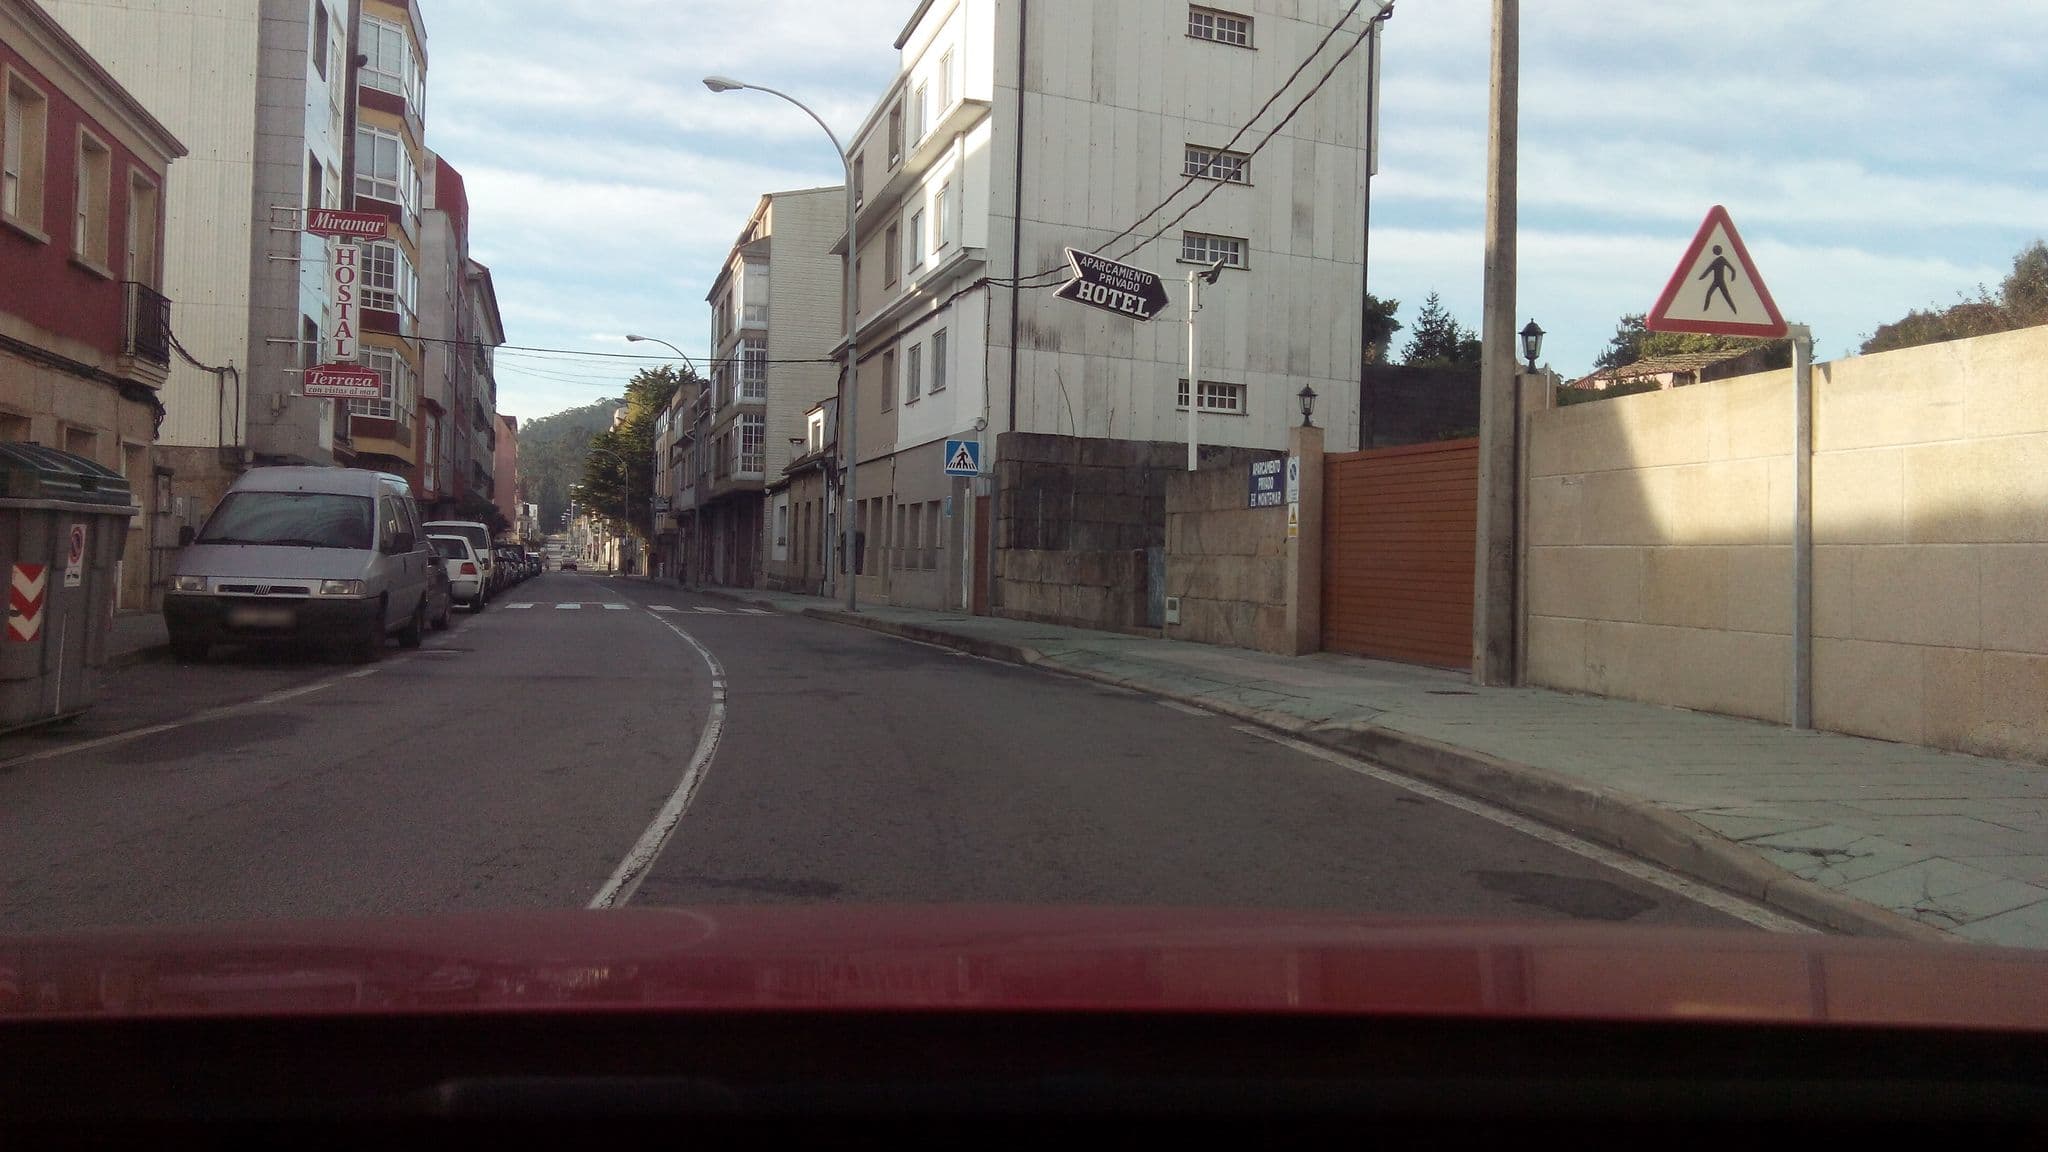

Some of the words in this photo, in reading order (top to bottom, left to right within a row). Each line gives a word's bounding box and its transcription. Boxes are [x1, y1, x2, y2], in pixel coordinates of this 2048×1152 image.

[310, 212, 385, 233] Miramar
[1080, 256, 1152, 285] APARCAMIENTO
[1099, 272, 1140, 292] PRIVADO
[334, 248, 356, 356] HOSTAL
[1076, 280, 1150, 318] HOTEL
[310, 372, 373, 387] Terraza
[308, 386, 322, 394] con
[349, 388, 358, 396] al
